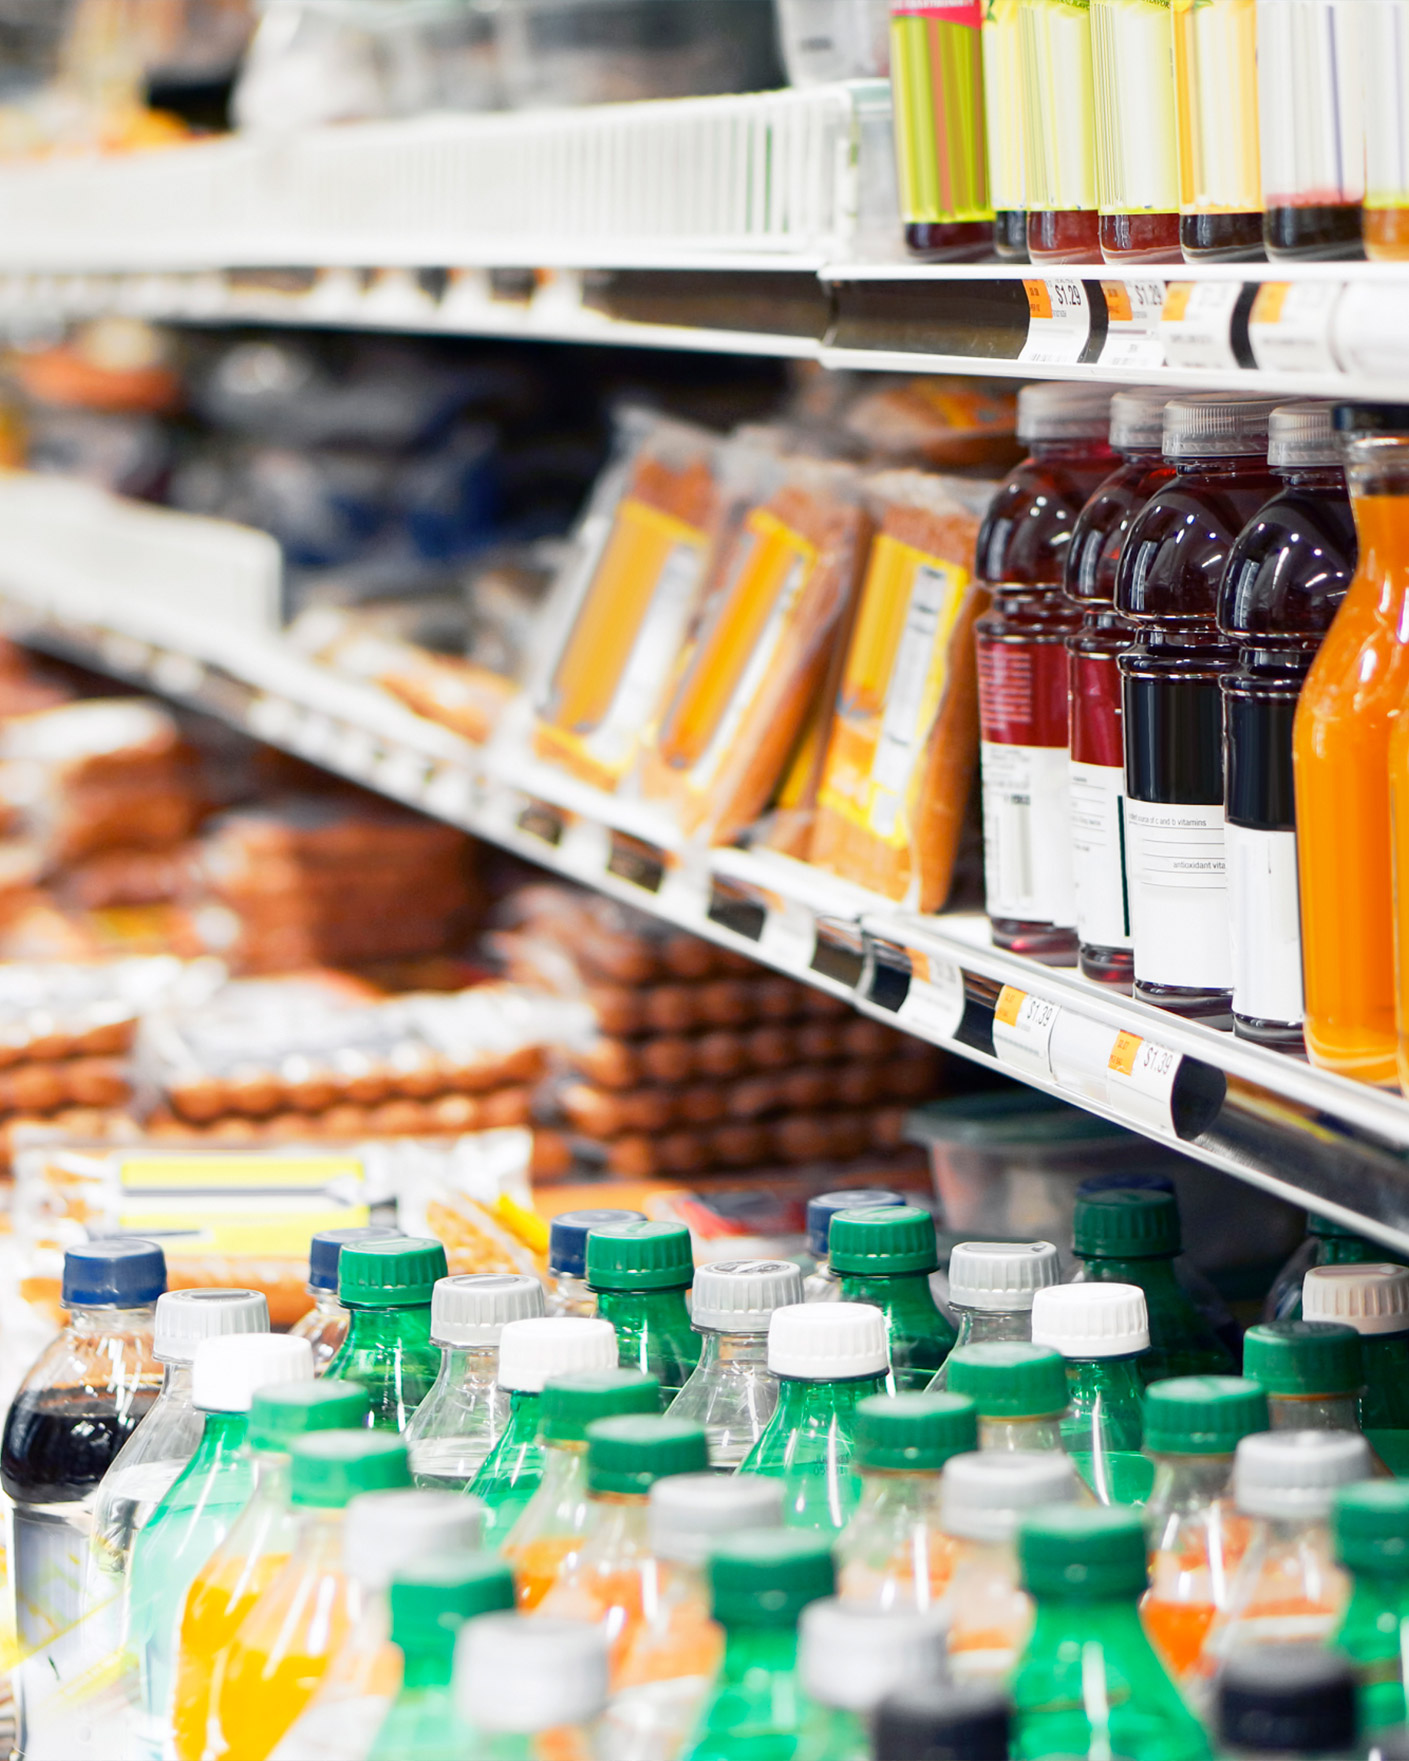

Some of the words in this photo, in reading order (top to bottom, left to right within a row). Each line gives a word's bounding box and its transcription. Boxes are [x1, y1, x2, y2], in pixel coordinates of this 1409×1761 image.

[1055, 284, 1082, 306] $1.29
[1177, 818, 1207, 827] vitamins
[1173, 861, 1211, 870] antioxidant
[1026, 1000, 1053, 1027] $1.39
[1143, 1046, 1173, 1075] $1.39
